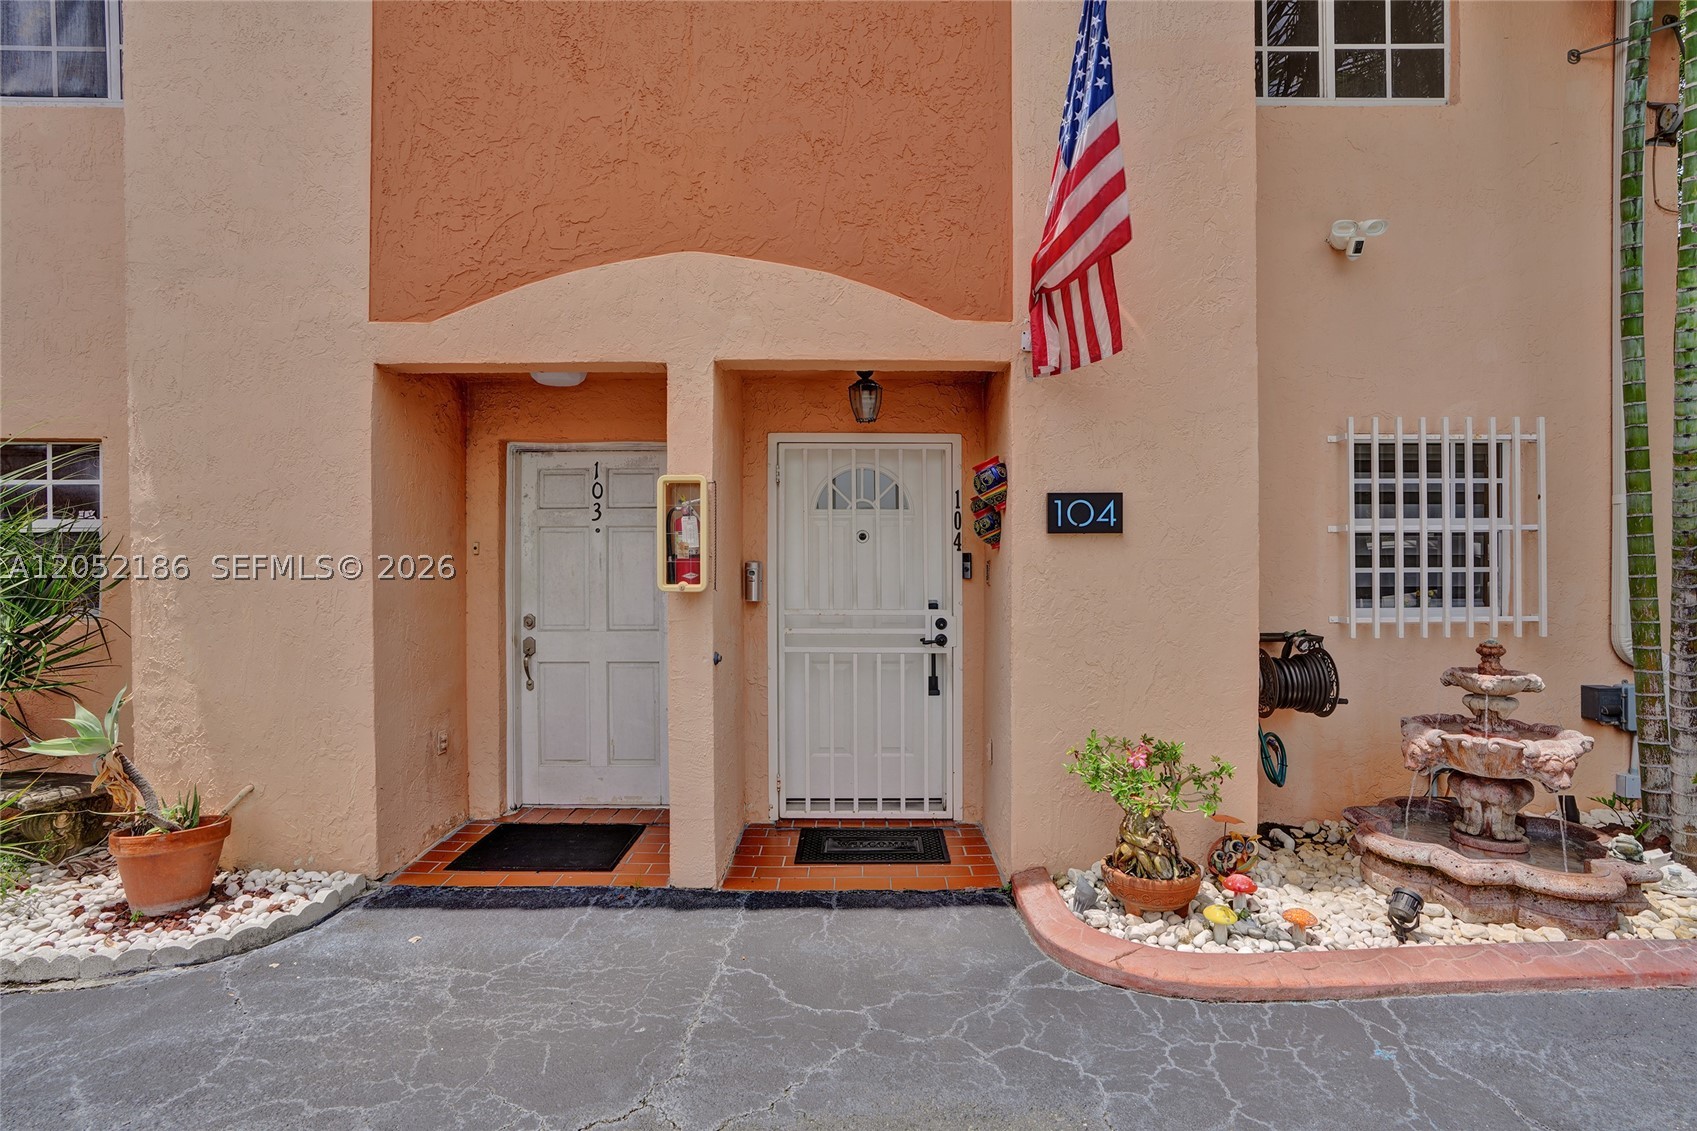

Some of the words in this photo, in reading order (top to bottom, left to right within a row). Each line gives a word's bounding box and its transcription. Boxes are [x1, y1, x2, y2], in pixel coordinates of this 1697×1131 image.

[591, 461, 604, 521] 103
[953, 489, 962, 551] 104
[1053, 499, 1117, 527] 104
